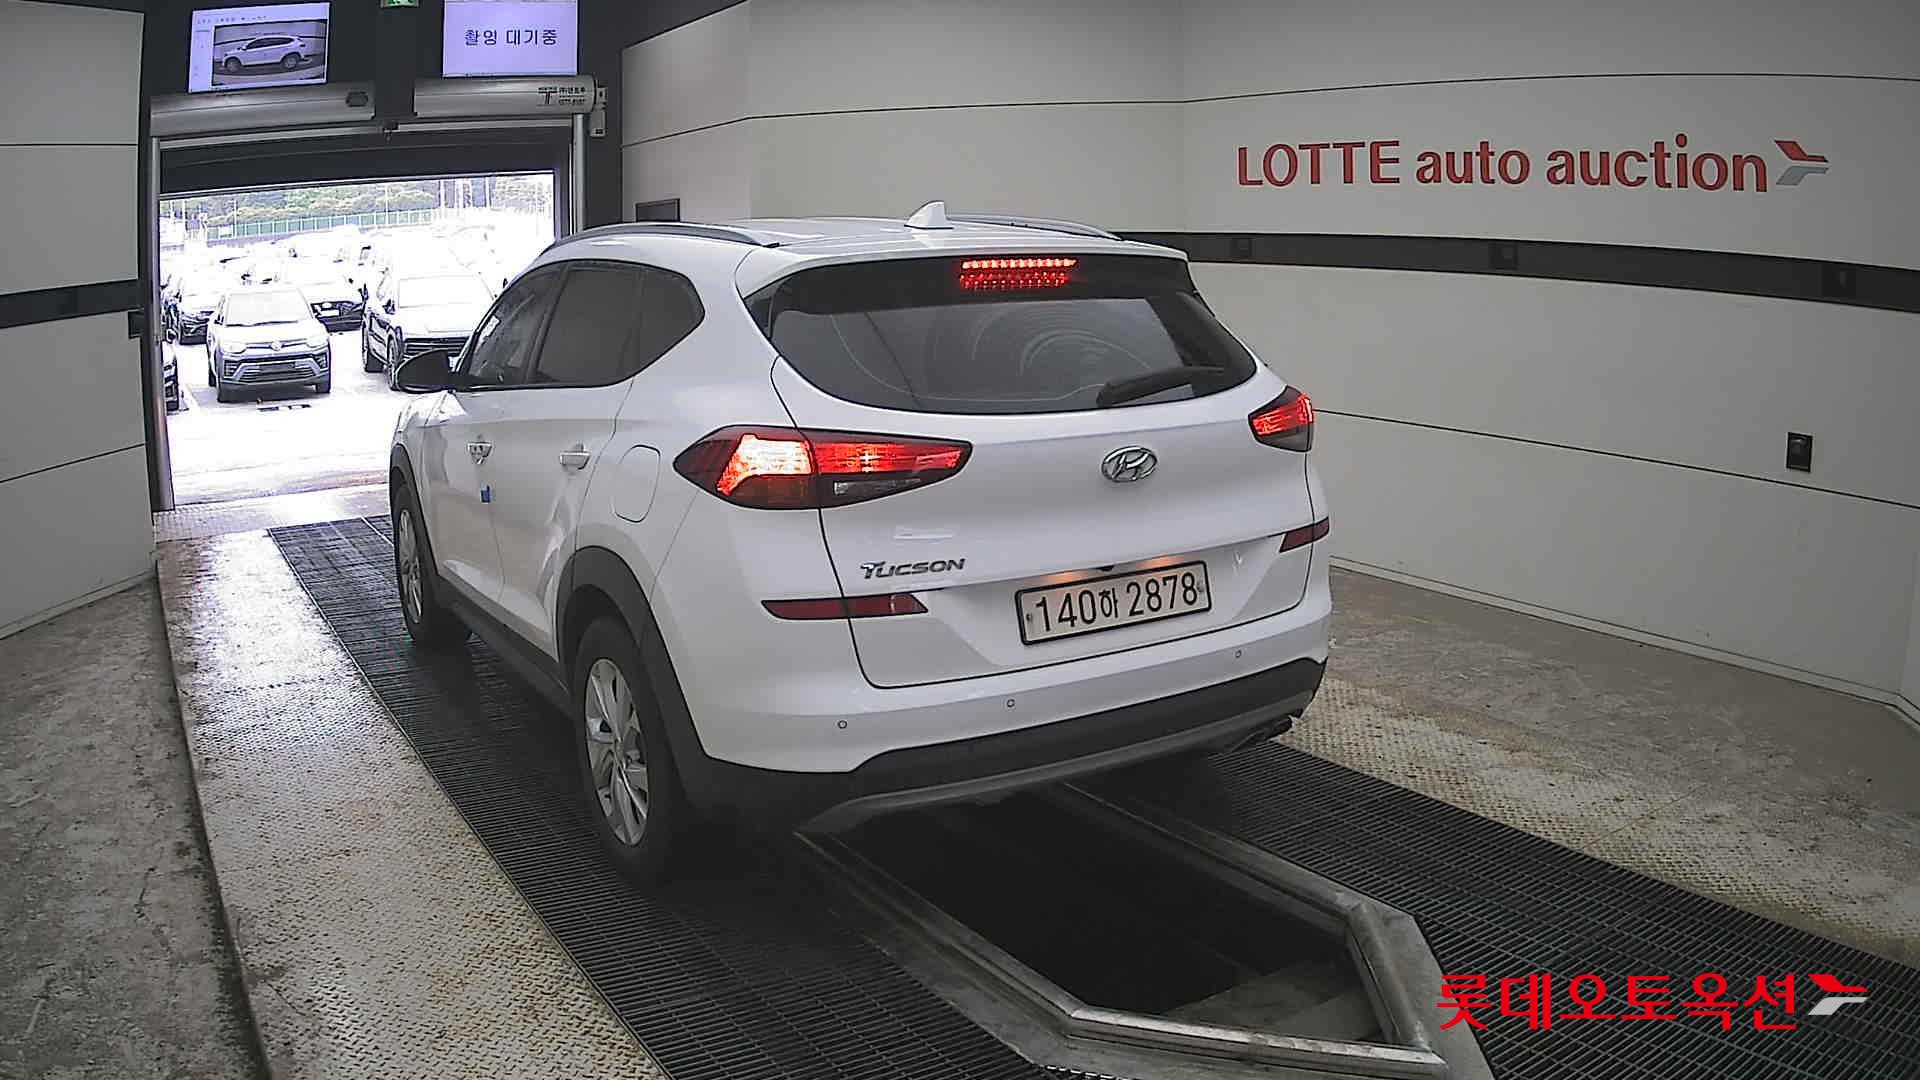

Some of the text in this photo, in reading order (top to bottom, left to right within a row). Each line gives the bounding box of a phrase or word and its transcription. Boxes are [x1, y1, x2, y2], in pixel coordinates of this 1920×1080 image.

[464, 29, 558, 47] 촬영 대기중
[1237, 133, 1768, 193] LOTTE auto auction
[860, 557, 966, 580] TUCSON
[1035, 572, 1198, 632] 140하 2878
